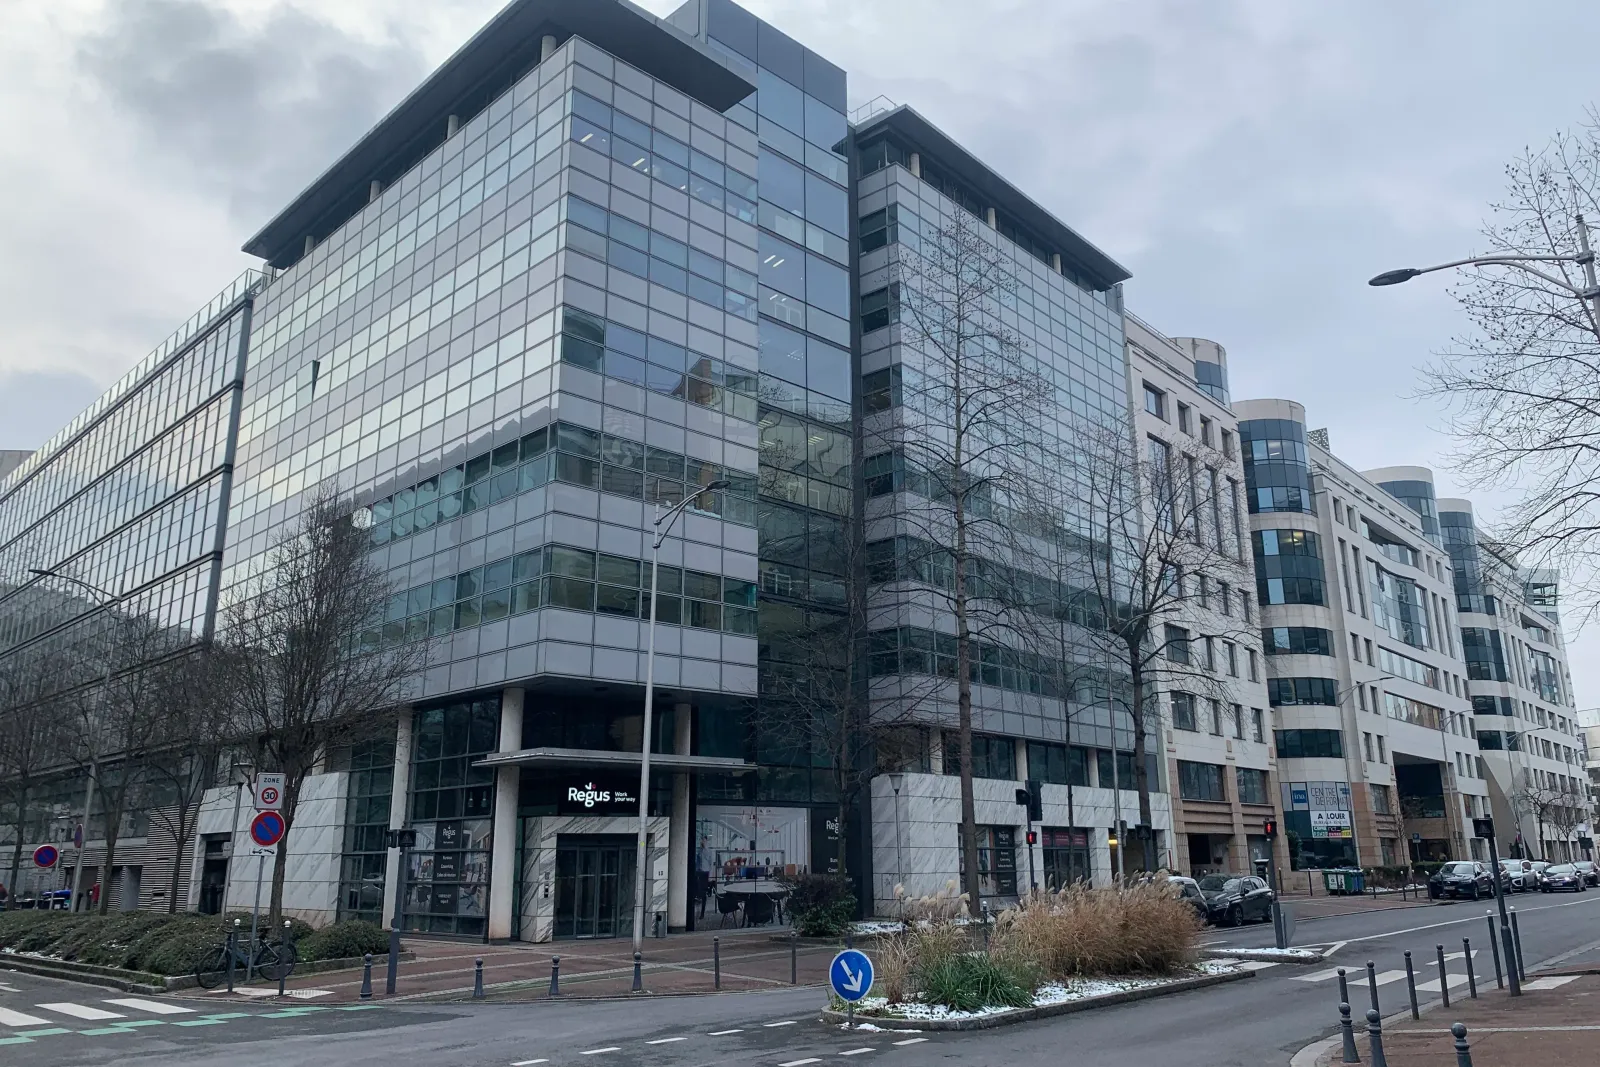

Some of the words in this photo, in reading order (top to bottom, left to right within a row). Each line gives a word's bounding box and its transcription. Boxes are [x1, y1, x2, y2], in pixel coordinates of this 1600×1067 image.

[568, 787, 611, 808] Regus
[1311, 788, 1336, 797] CENTRE
[442, 828, 456, 839] Regus
